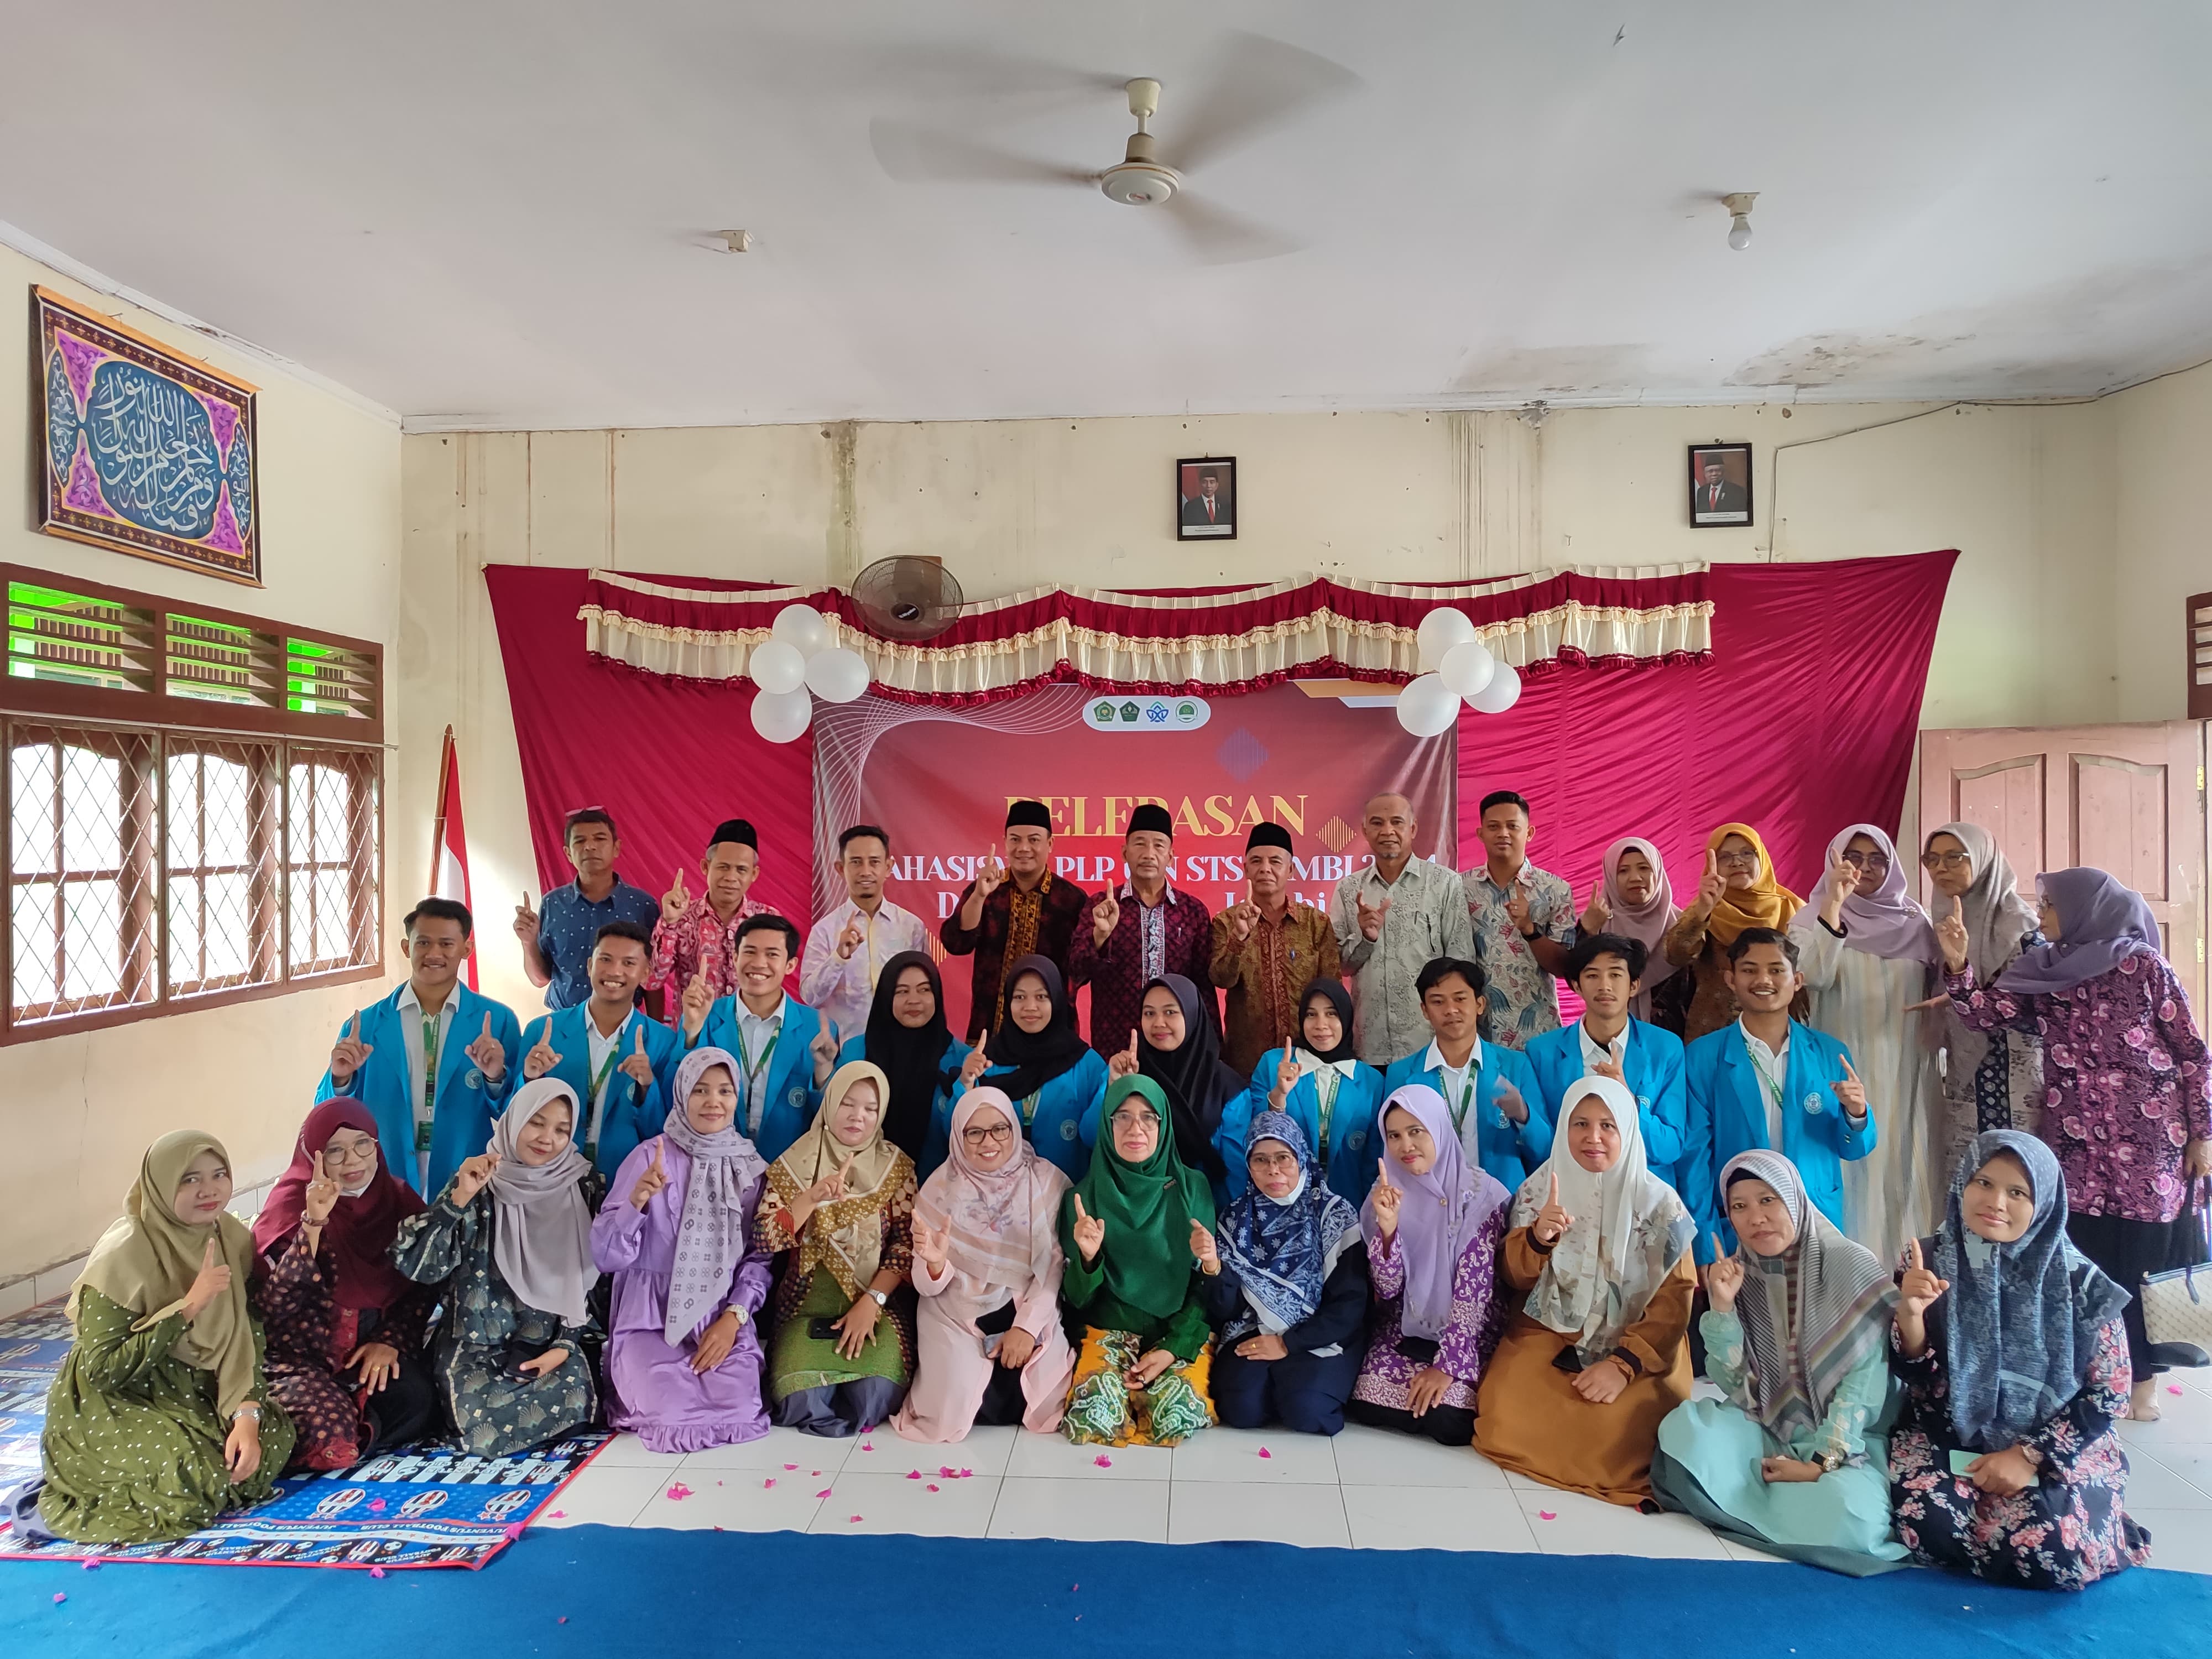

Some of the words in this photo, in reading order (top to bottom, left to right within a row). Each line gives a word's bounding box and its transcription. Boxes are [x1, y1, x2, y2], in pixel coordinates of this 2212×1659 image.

[1056, 855, 1114, 881] PLP
[1186, 855, 1244, 881] STS
[220, 1521, 275, 1530] FOOTBALL
[393, 1523, 449, 1532] FOOTBALL
